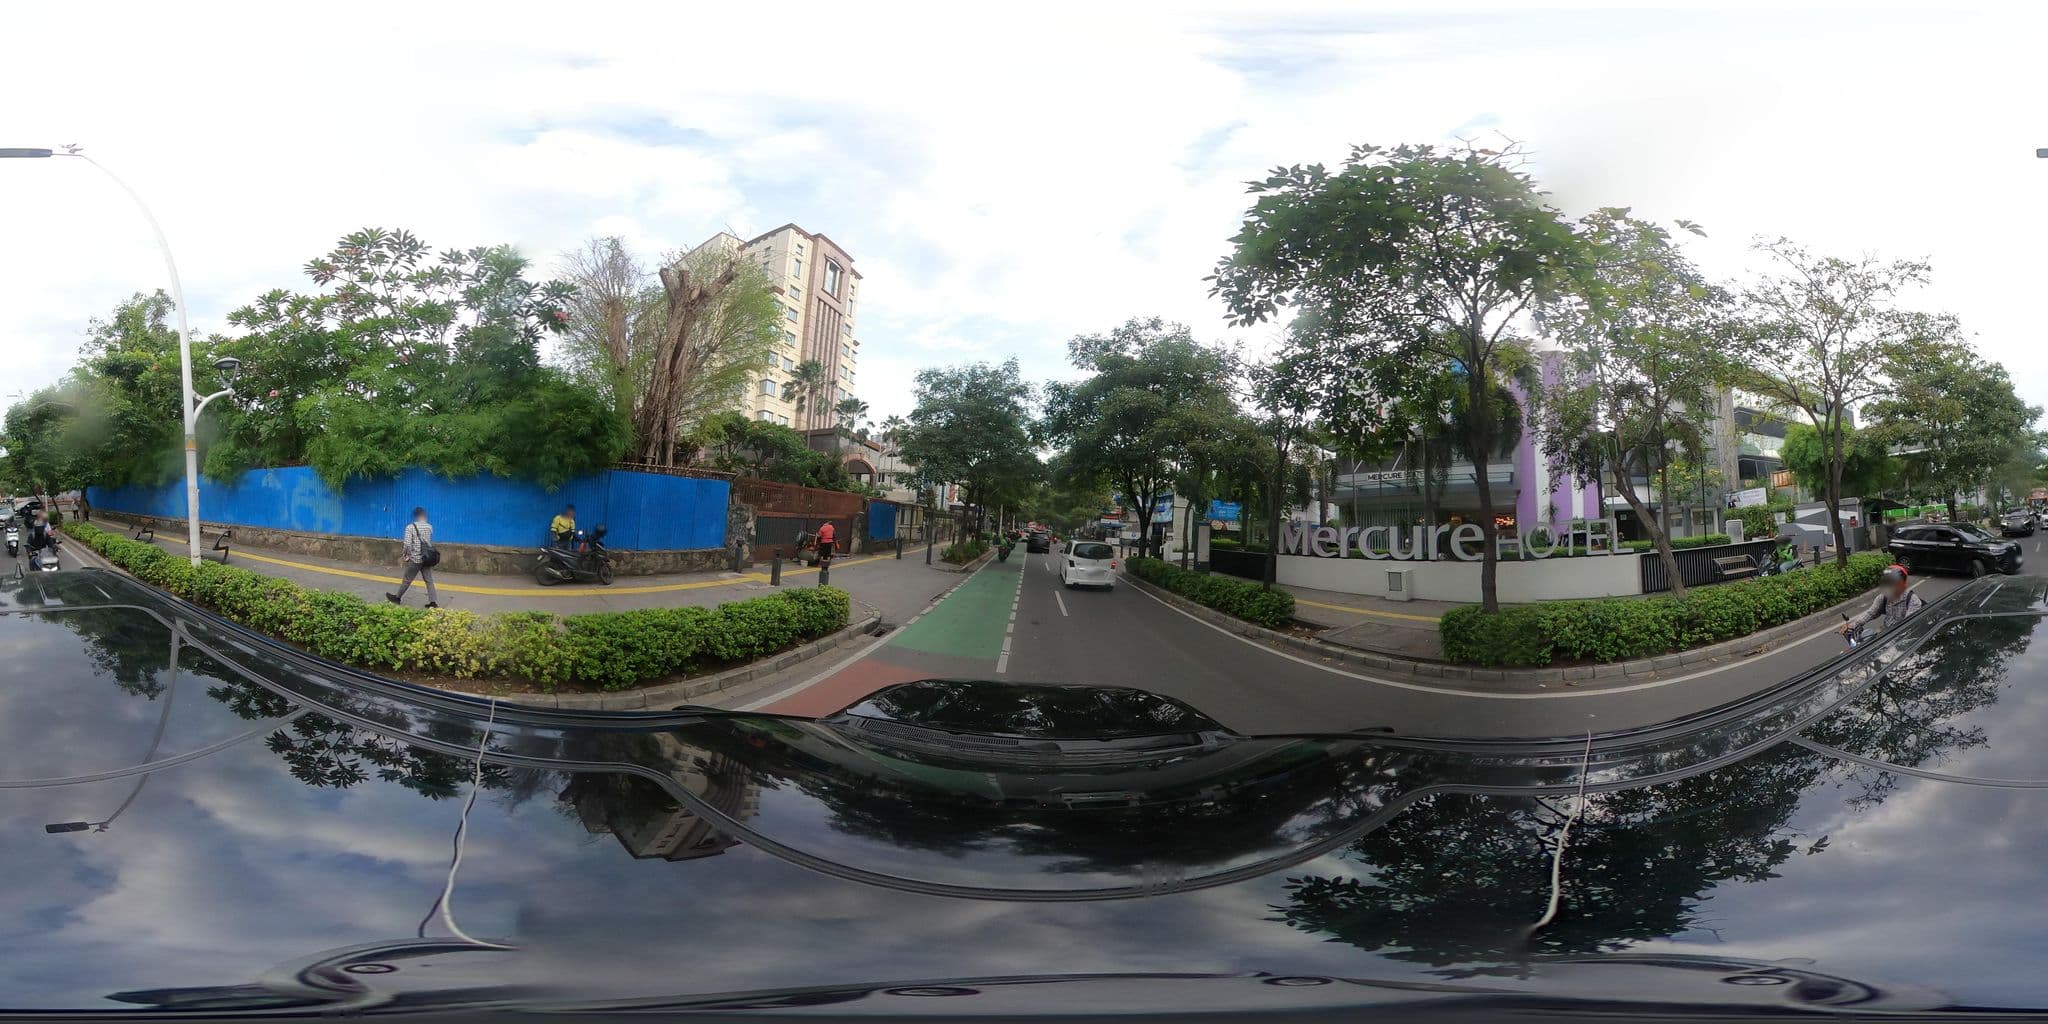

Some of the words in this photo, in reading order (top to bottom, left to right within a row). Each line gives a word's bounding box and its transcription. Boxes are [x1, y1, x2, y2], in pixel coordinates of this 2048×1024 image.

[1367, 471, 1402, 481] MERCURE
[1279, 520, 1485, 561] Mercure
[1495, 517, 1635, 561] HOTEL
